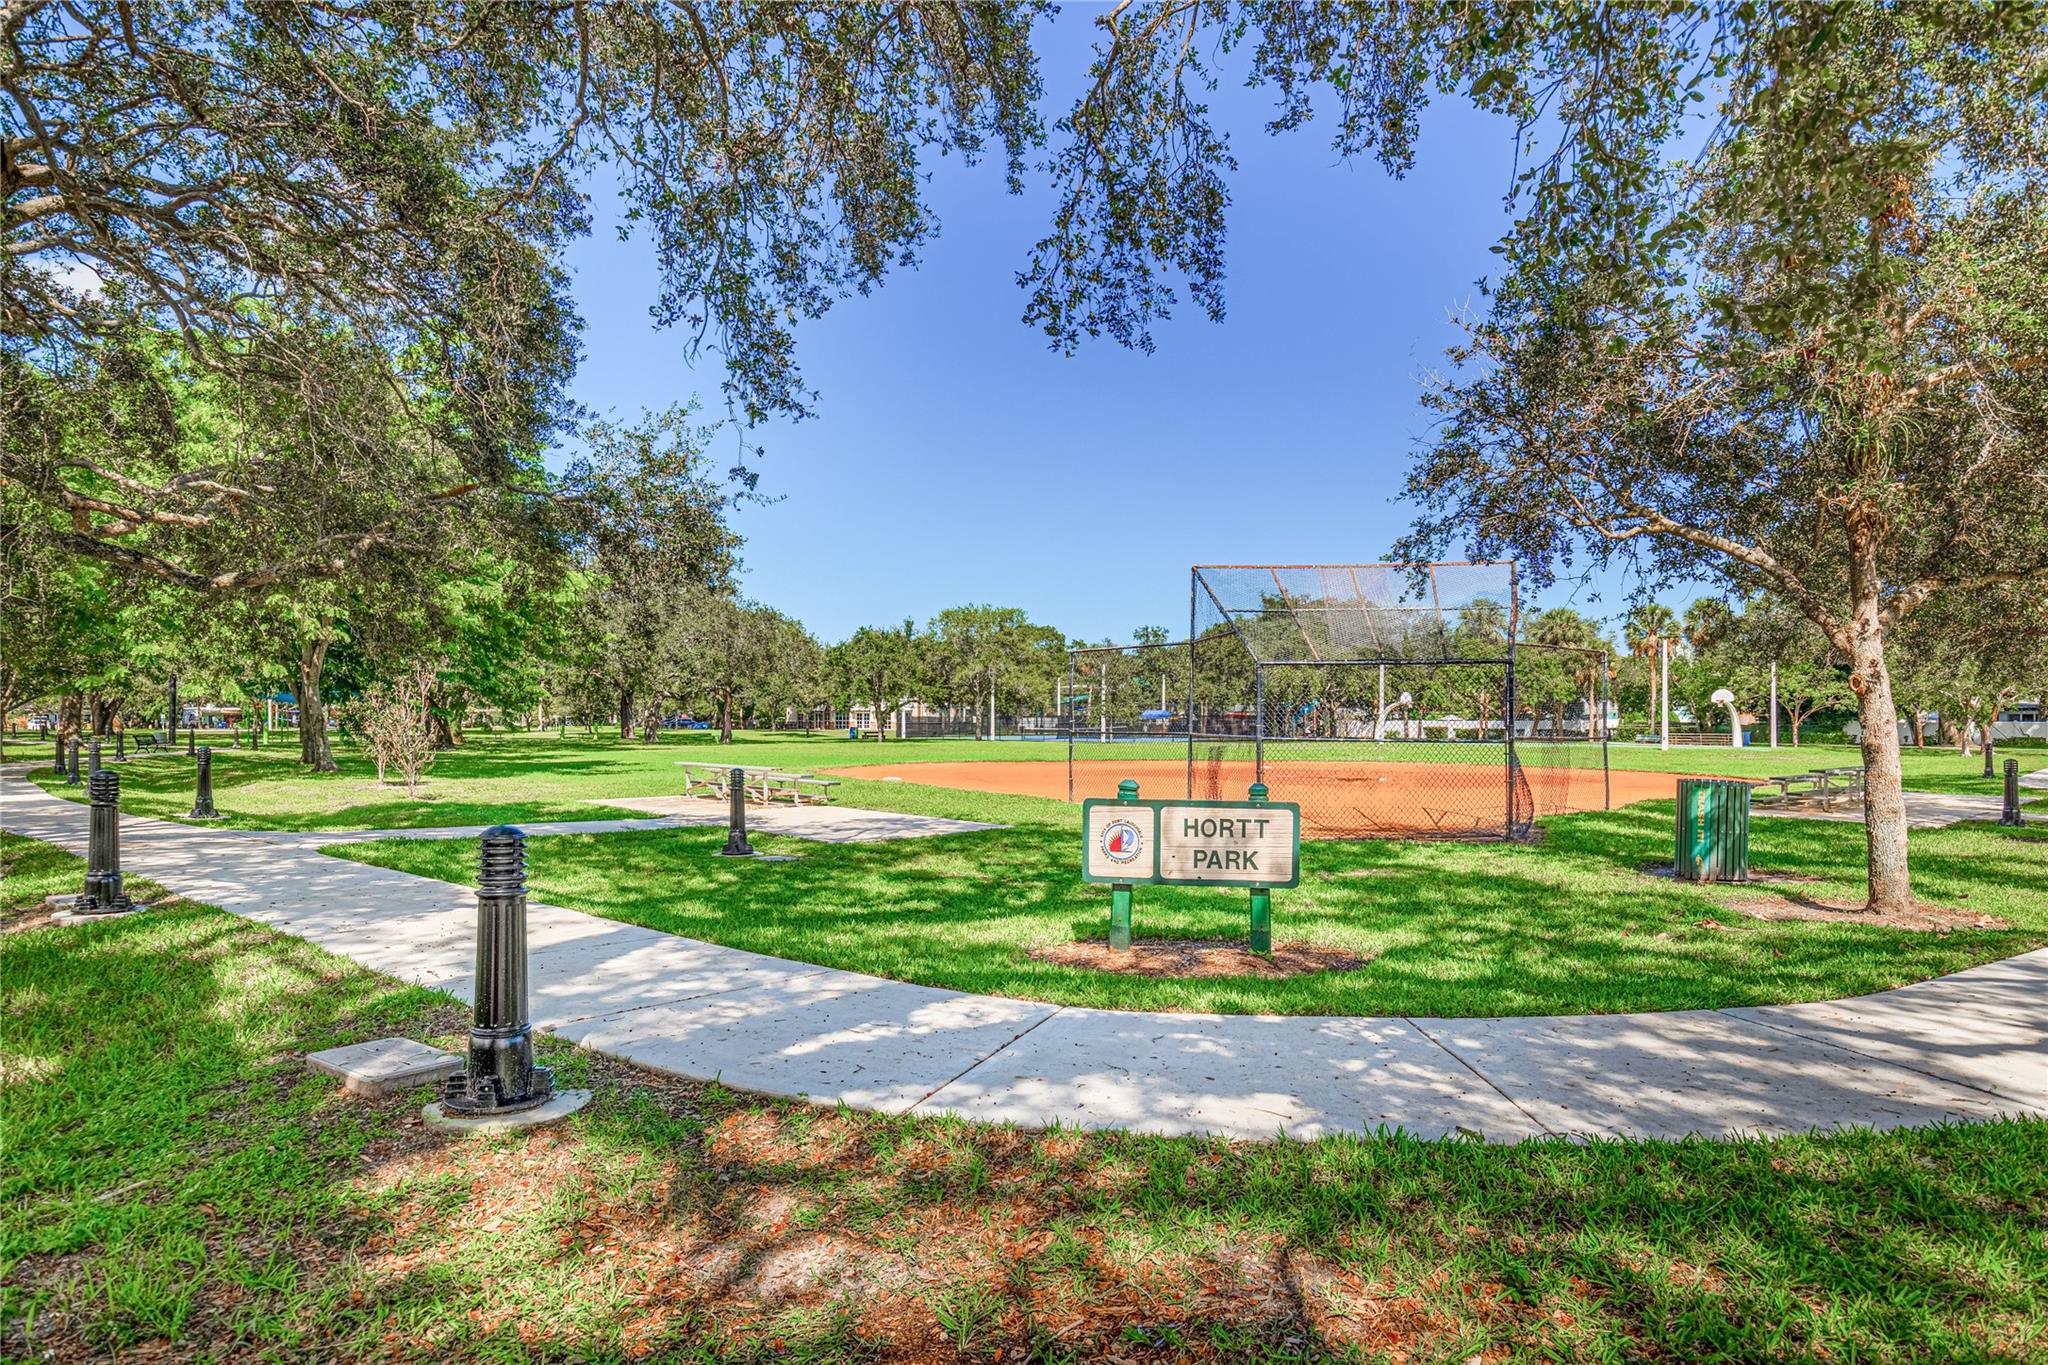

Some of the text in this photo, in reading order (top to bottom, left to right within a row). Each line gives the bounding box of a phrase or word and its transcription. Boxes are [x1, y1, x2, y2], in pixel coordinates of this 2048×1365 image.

[1697, 791, 1705, 826] TRASH
[1184, 818, 1270, 838] HORTT
[1193, 850, 1259, 870] PARK
